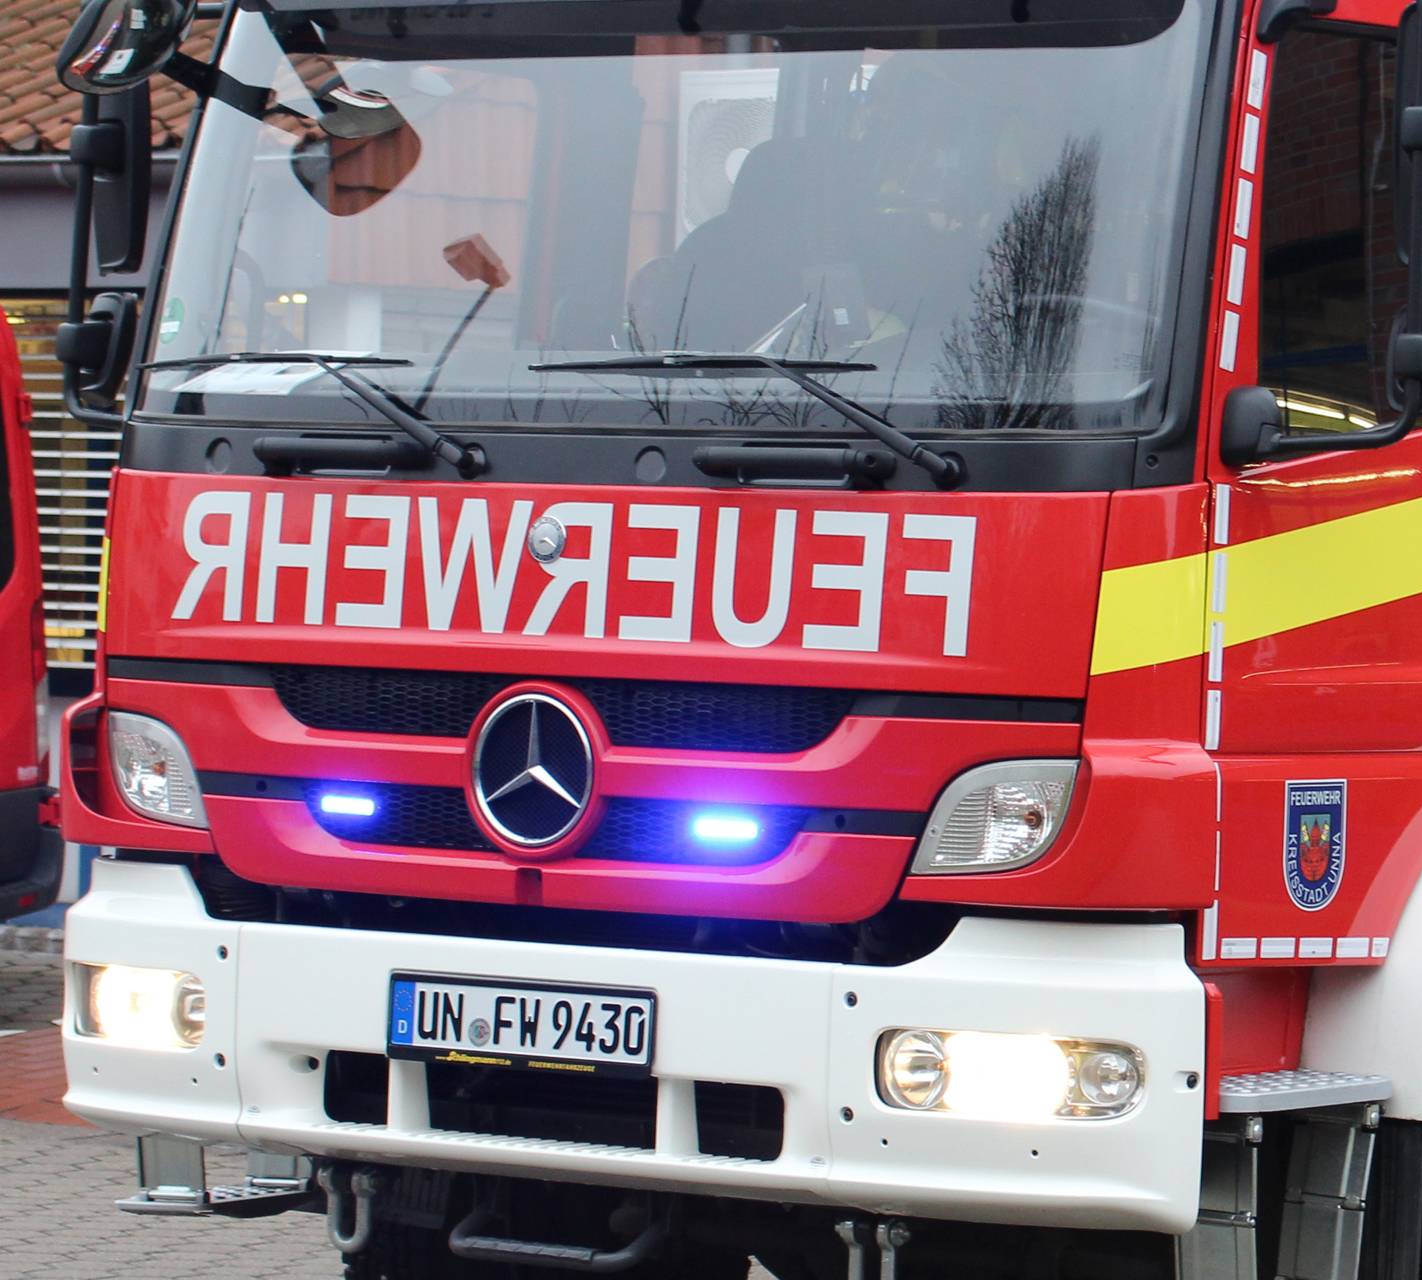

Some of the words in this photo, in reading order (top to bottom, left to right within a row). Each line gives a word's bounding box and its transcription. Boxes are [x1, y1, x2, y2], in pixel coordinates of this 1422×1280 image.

[1290, 790, 1341, 806] FEUERWEHR
[1288, 833, 1329, 903] KREISSTADT
[1328, 832, 1341, 883] UNNA
[397, 1019, 408, 1034] D
[418, 990, 464, 1042] UN
[493, 996, 541, 1047] FW
[552, 1000, 646, 1055] 9430
